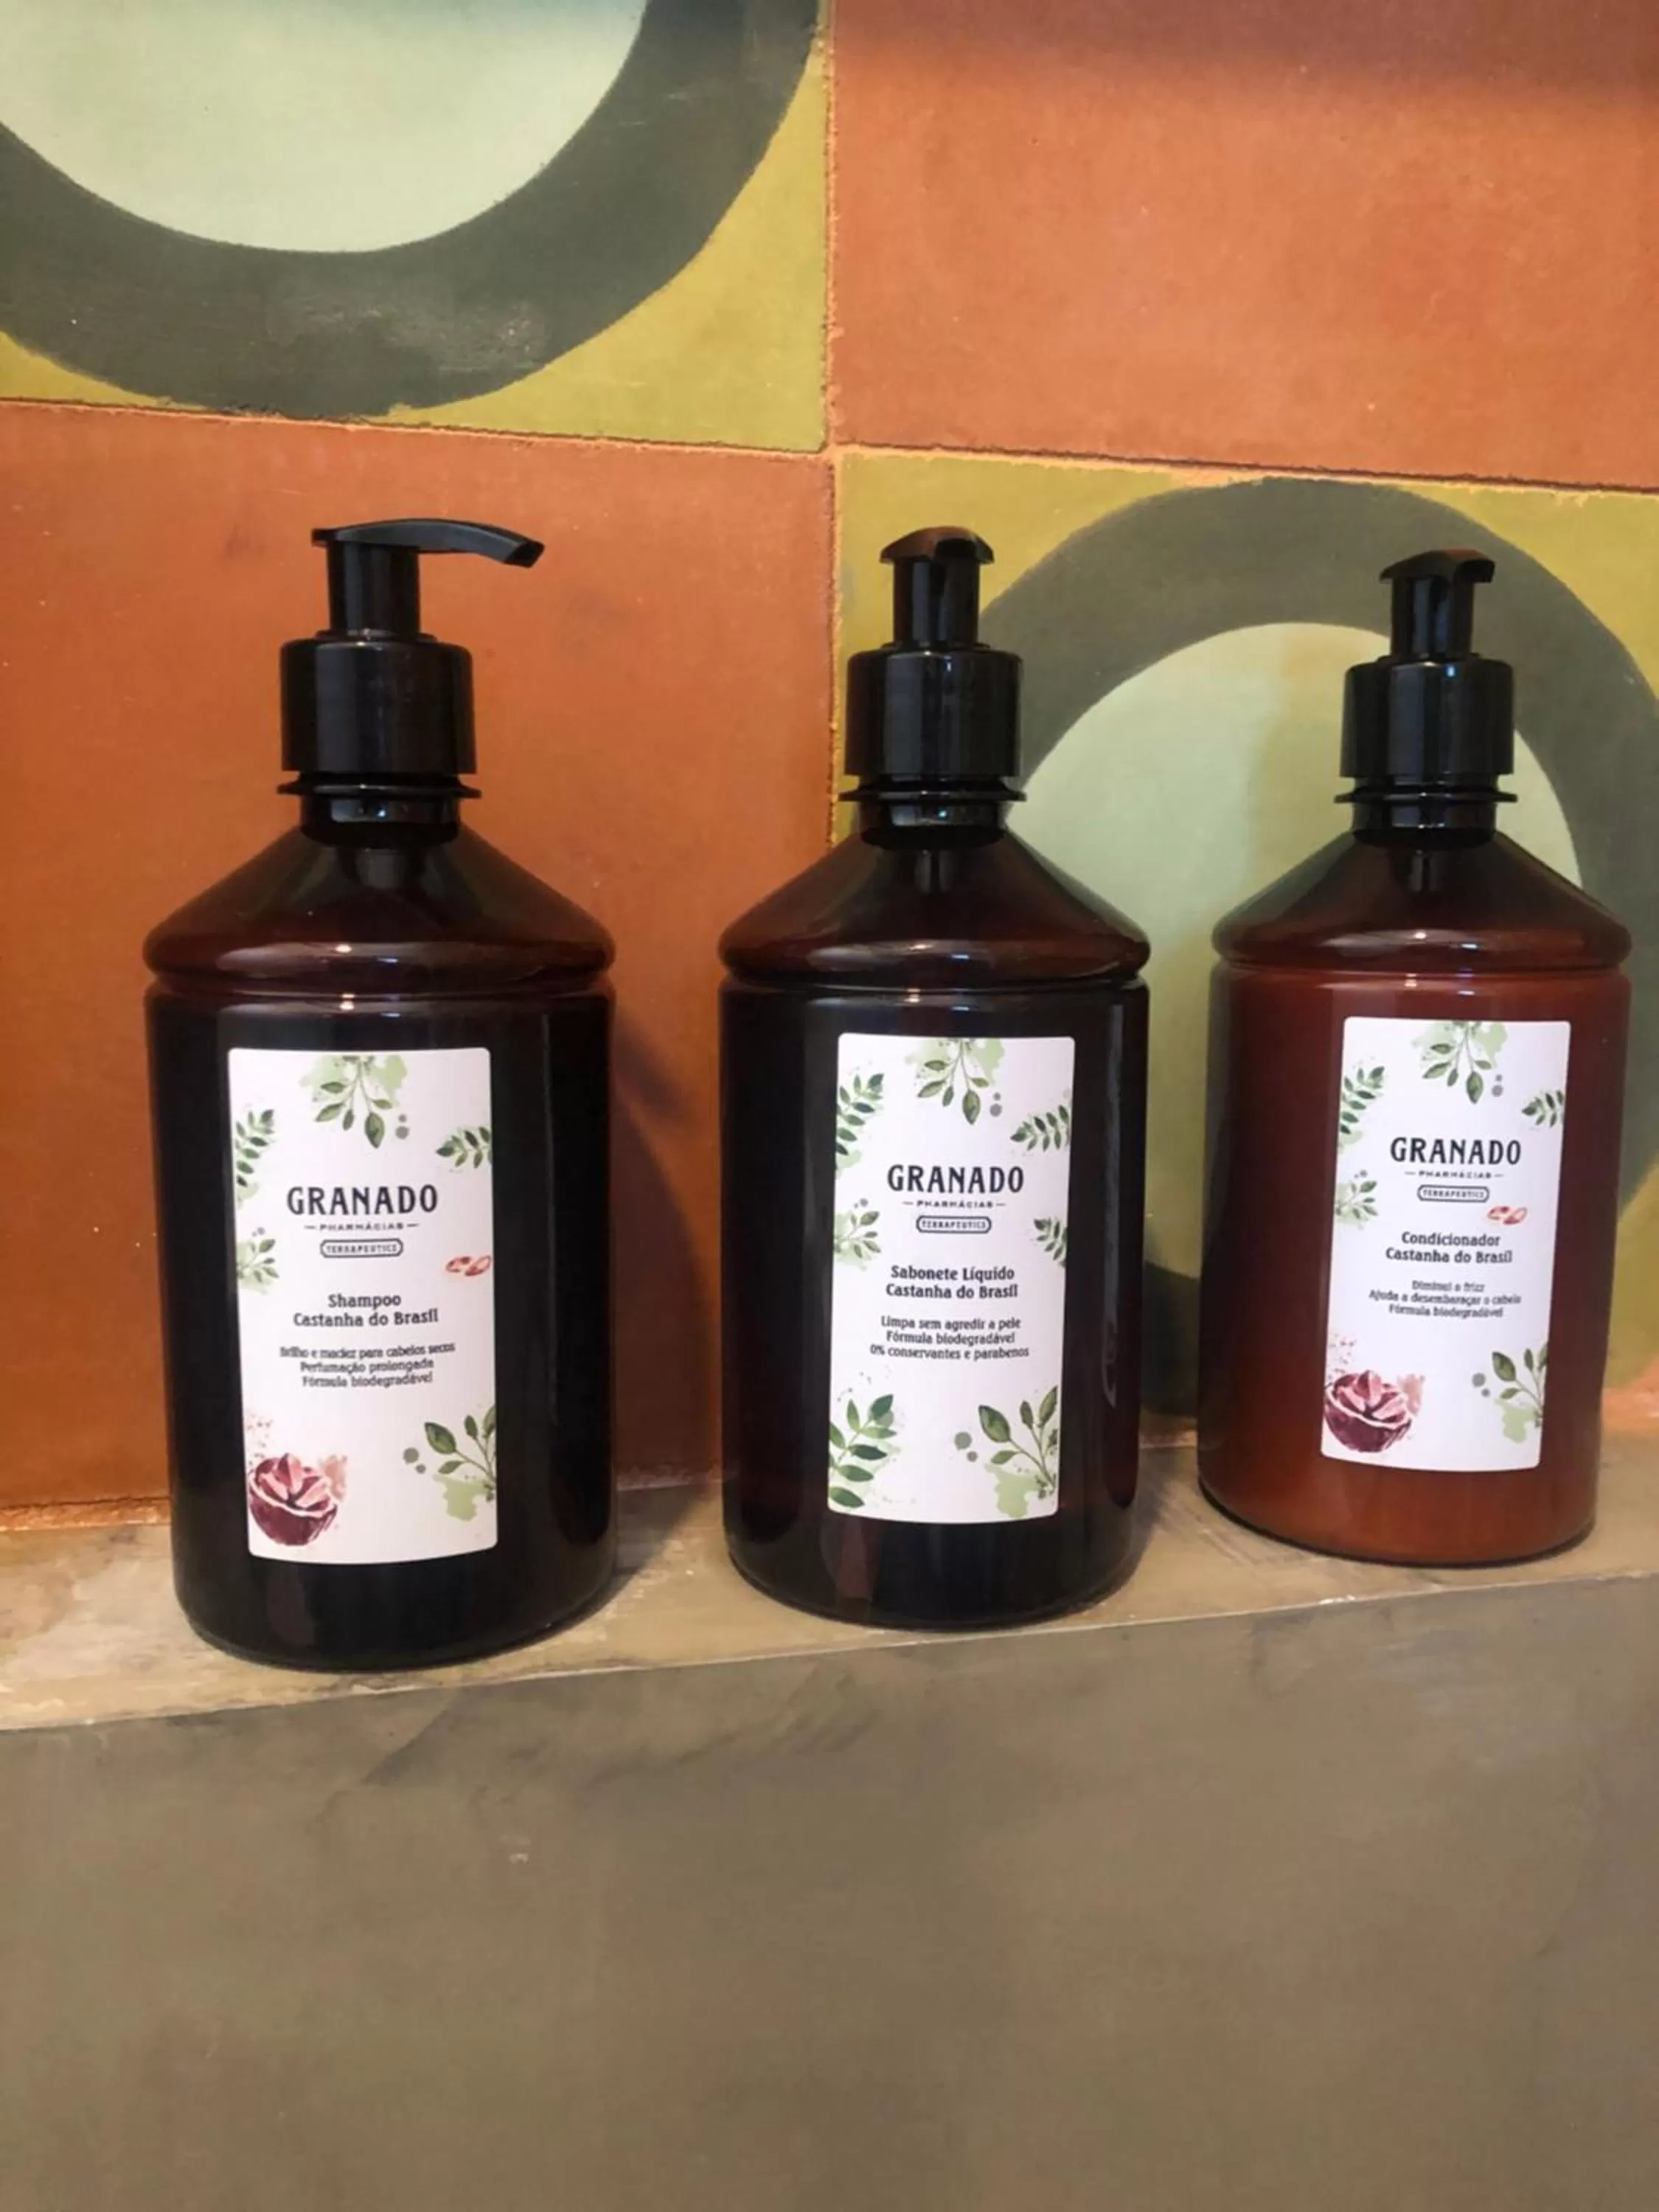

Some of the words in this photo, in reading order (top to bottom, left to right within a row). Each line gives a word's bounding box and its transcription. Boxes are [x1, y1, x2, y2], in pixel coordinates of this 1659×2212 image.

[1391, 1137, 1522, 1165] GRANADO
[887, 1164, 1024, 1194] GRANADO
[1419, 1170, 1492, 1178] PHARMÁCIAS
[286, 1184, 438, 1216] GRANADO
[917, 1200, 993, 1208] PHARMÁCIAS
[319, 1222, 404, 1231] PHARMÁCIAS
[1402, 1231, 1501, 1246] Condicionador
[1385, 1248, 1450, 1262] Castanha
[1454, 1251, 1472, 1263] do
[1475, 1251, 1513, 1263] Brasil
[891, 1265, 958, 1280] Sabonete
[962, 1267, 1015, 1283] Líquido
[886, 1284, 952, 1298] Castanha
[956, 1284, 975, 1298] do
[979, 1284, 1018, 1298] Brasil
[1368, 1289, 1399, 1302] Ajuda
[1411, 1292, 1481, 1307] desembaraçar
[327, 1293, 402, 1310] Shampoo
[293, 1312, 364, 1326] Castanha
[369, 1311, 389, 1326] do
[394, 1308, 439, 1324] Brasil
[1389, 1304, 1430, 1315] Fórmula
[1433, 1307, 1503, 1318] biodegradável
[881, 1315, 915, 1329] Limpa
[919, 1319, 942, 1329] sem
[945, 1318, 985, 1332] agredir
[988, 1320, 995, 1329] a
[998, 1317, 1020, 1331] pele
[886, 1331, 932, 1343] Fórmula
[936, 1332, 1015, 1346] biodegradável
[279, 1346, 308, 1358] Brilho
[310, 1349, 317, 1358] e
[358, 1347, 383, 1360] para
[386, 1345, 425, 1357] cabelos
[428, 1343, 456, 1354] secos
[870, 1345, 885, 1355] 0%
[888, 1347, 961, 1360] conservantes
[964, 1350, 970, 1359] e
[974, 1347, 1029, 1361] parabenos
[300, 1361, 366, 1375] Perfumação
[369, 1359, 434, 1374] prolongada
[302, 1376, 347, 1388] Fórmula
[351, 1371, 433, 1388] biodegradável
